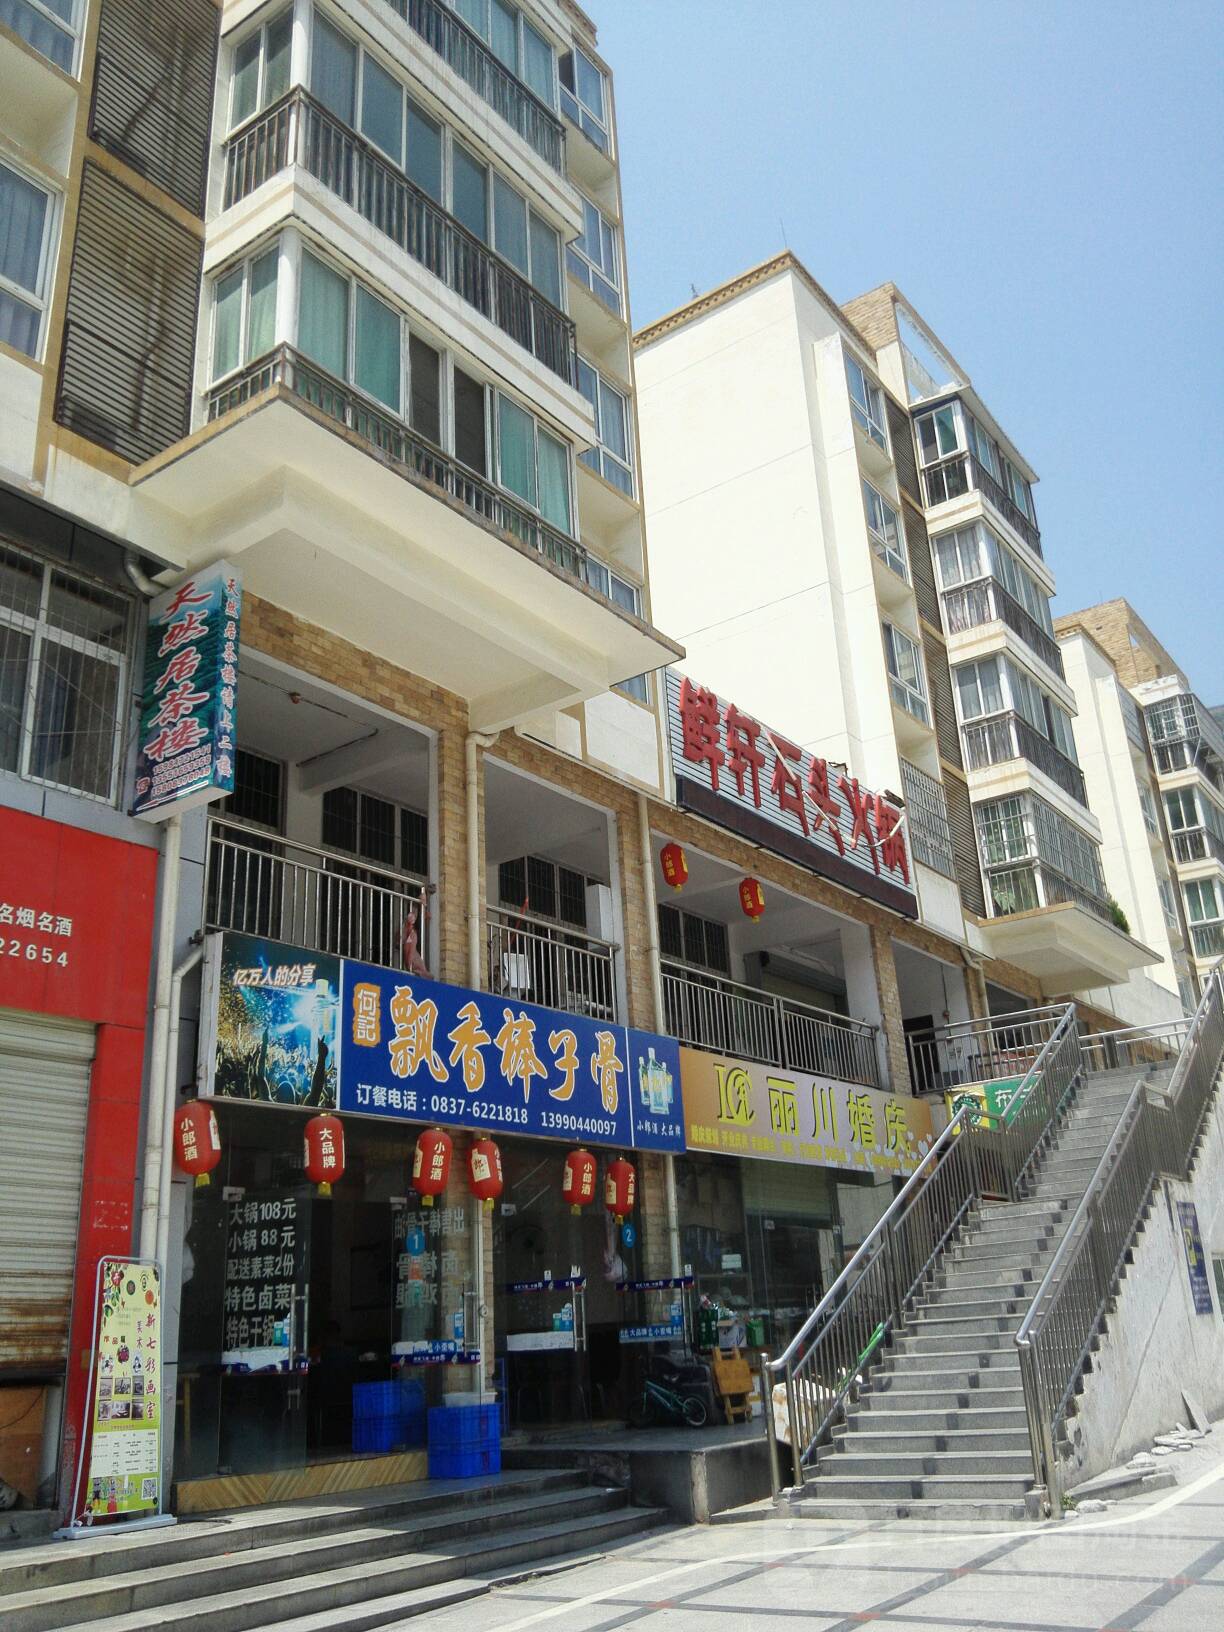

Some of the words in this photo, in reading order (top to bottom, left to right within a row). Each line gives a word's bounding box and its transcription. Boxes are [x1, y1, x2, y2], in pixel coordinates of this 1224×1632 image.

[143, 580, 212, 761] 天然居茶楼
[0, 903, 73, 937] 名烟名酒
[232, 962, 317, 987] 亿万人的分享
[388, 985, 624, 1116] 飘香棒子骨
[541, 1111, 618, 1137] 13990440097
[766, 1075, 911, 1151] 丽川婚庆
[181, 1117, 198, 1161] 小郎酒
[319, 1127, 337, 1169] 大品牌
[430, 1141, 446, 1181] 小郎酒
[581, 1161, 593, 1196] 小郎酒
[230, 1198, 297, 1226] 大锅108元
[413, 1234, 419, 1250] 1
[625, 1228, 632, 1242] 2
[224, 1283, 291, 1312] 特色卤菜
[144, 1311, 158, 1419] 新七彩画室
